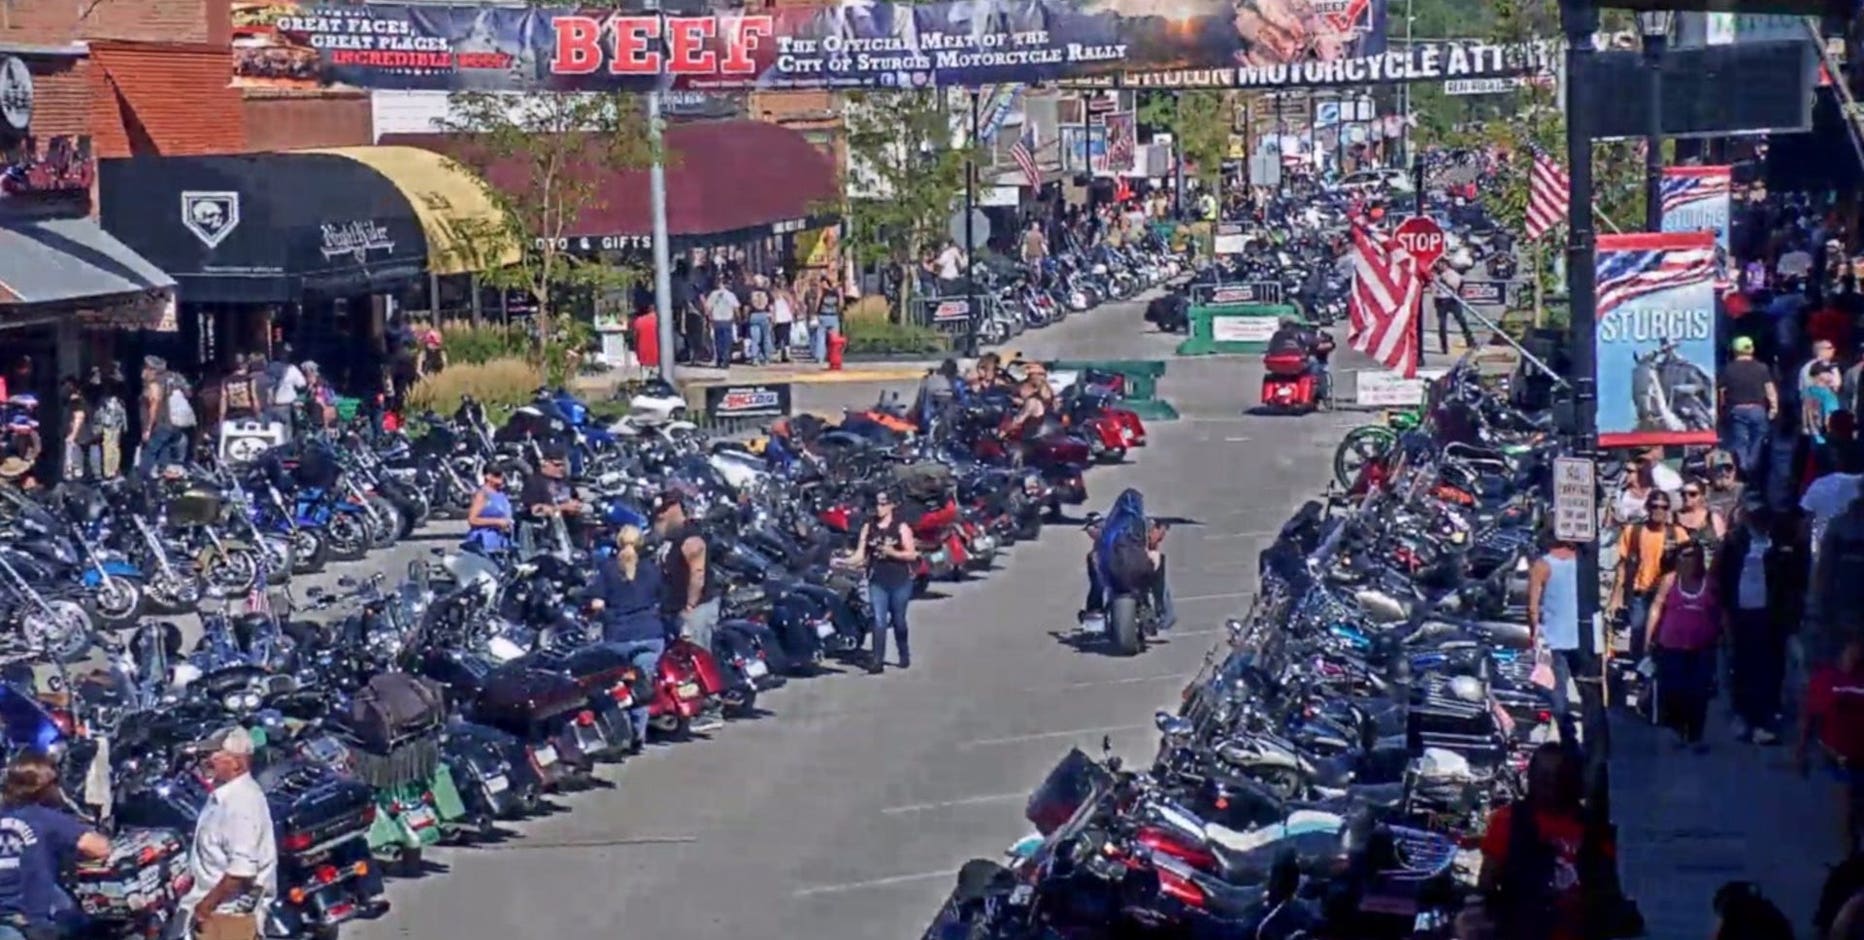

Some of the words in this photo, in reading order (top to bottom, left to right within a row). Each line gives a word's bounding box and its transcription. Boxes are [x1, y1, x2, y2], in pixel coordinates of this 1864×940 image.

[277, 17, 345, 31] GREAT
[347, 18, 416, 36] FACES,
[310, 34, 373, 49] GREAT
[376, 36, 454, 53] PLACES,
[551, 16, 773, 75] BEEF
[777, 36, 816, 53] THE
[823, 35, 911, 52] OFFICIAL
[920, 32, 977, 50] MEAT
[983, 33, 1008, 47] OF
[1012, 31, 1049, 45] THE
[331, 51, 451, 67] INCREDIBLE
[777, 55, 823, 73] CITY
[828, 58, 852, 71] OF
[857, 54, 930, 70] STURGIS
[935, 49, 1062, 68] MOTORCYCLE
[1067, 43, 1127, 61] RALLY
[1238, 44, 1441, 84] MOTORCYCLE
[602, 236, 652, 249] GIFTS
[1397, 233, 1441, 252] STOP
[1601, 308, 1709, 342] STURGIS
